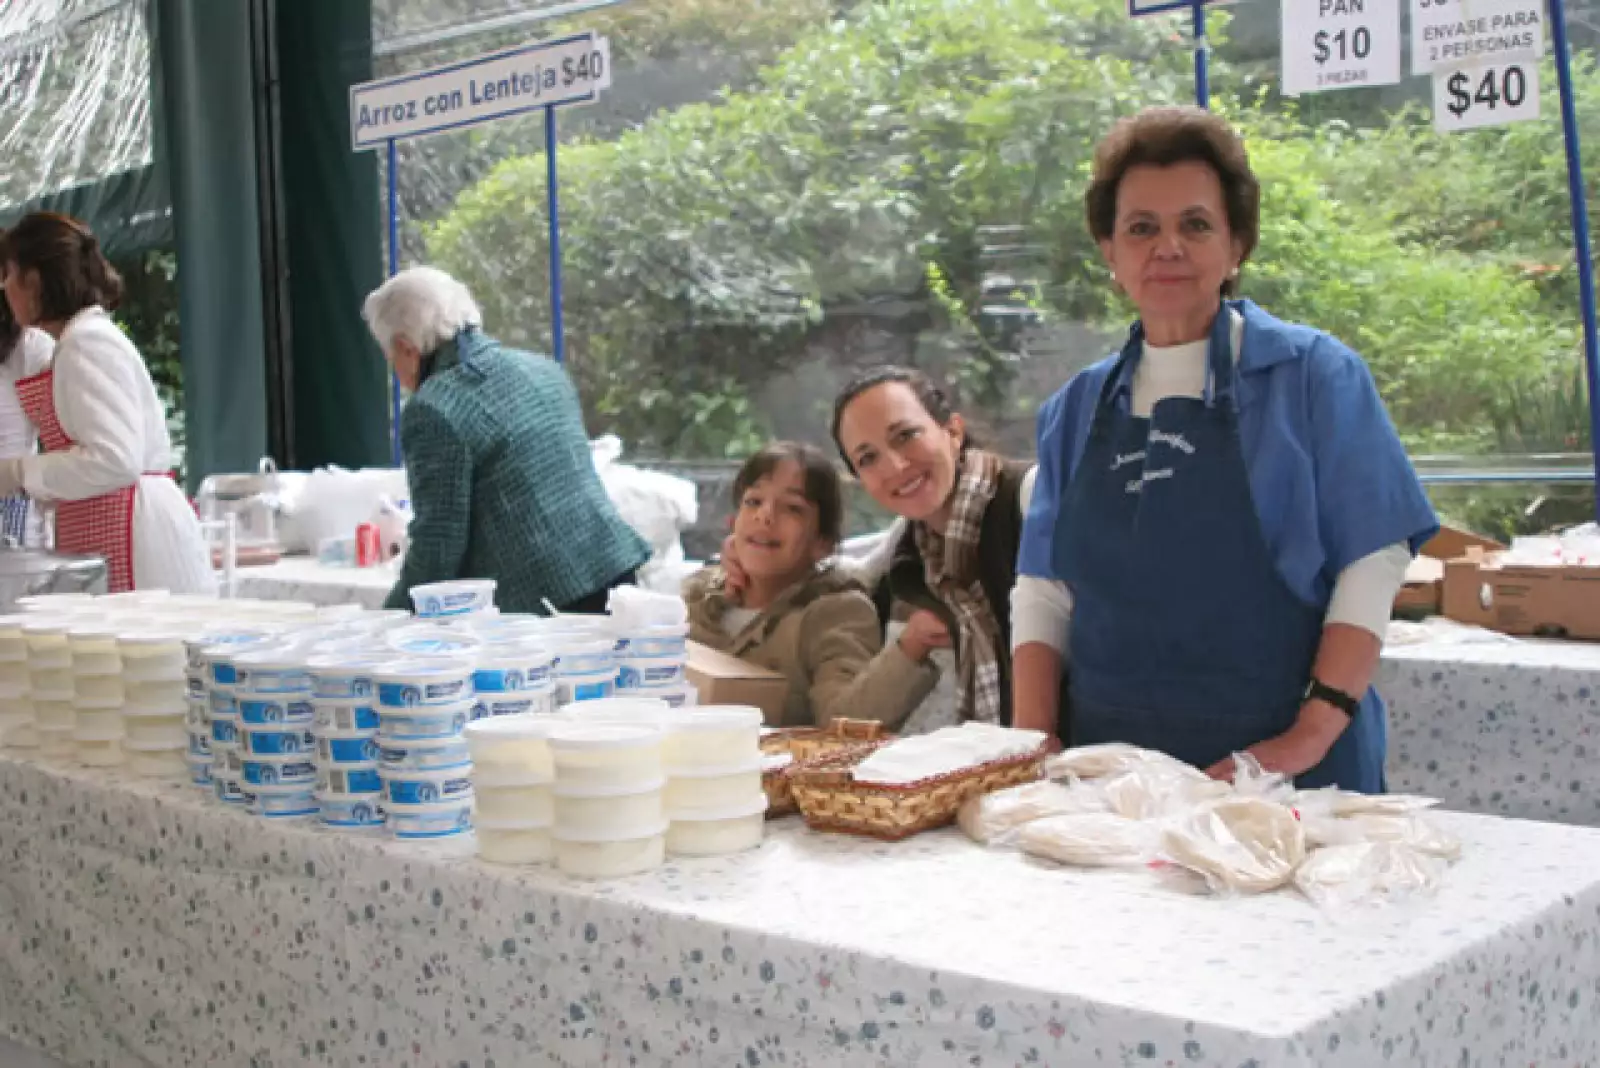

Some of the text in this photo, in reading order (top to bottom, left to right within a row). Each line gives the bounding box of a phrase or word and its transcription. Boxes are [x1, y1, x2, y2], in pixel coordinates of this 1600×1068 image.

[1319, 0, 1363, 17] PAN
[1424, 9, 1539, 41] ENVASE PARA
[1313, 26, 1371, 64] $10
[1442, 31, 1534, 58] PERSONAS
[359, 49, 604, 126] Arroz con Lenteja $40
[1447, 64, 1526, 119] $40
